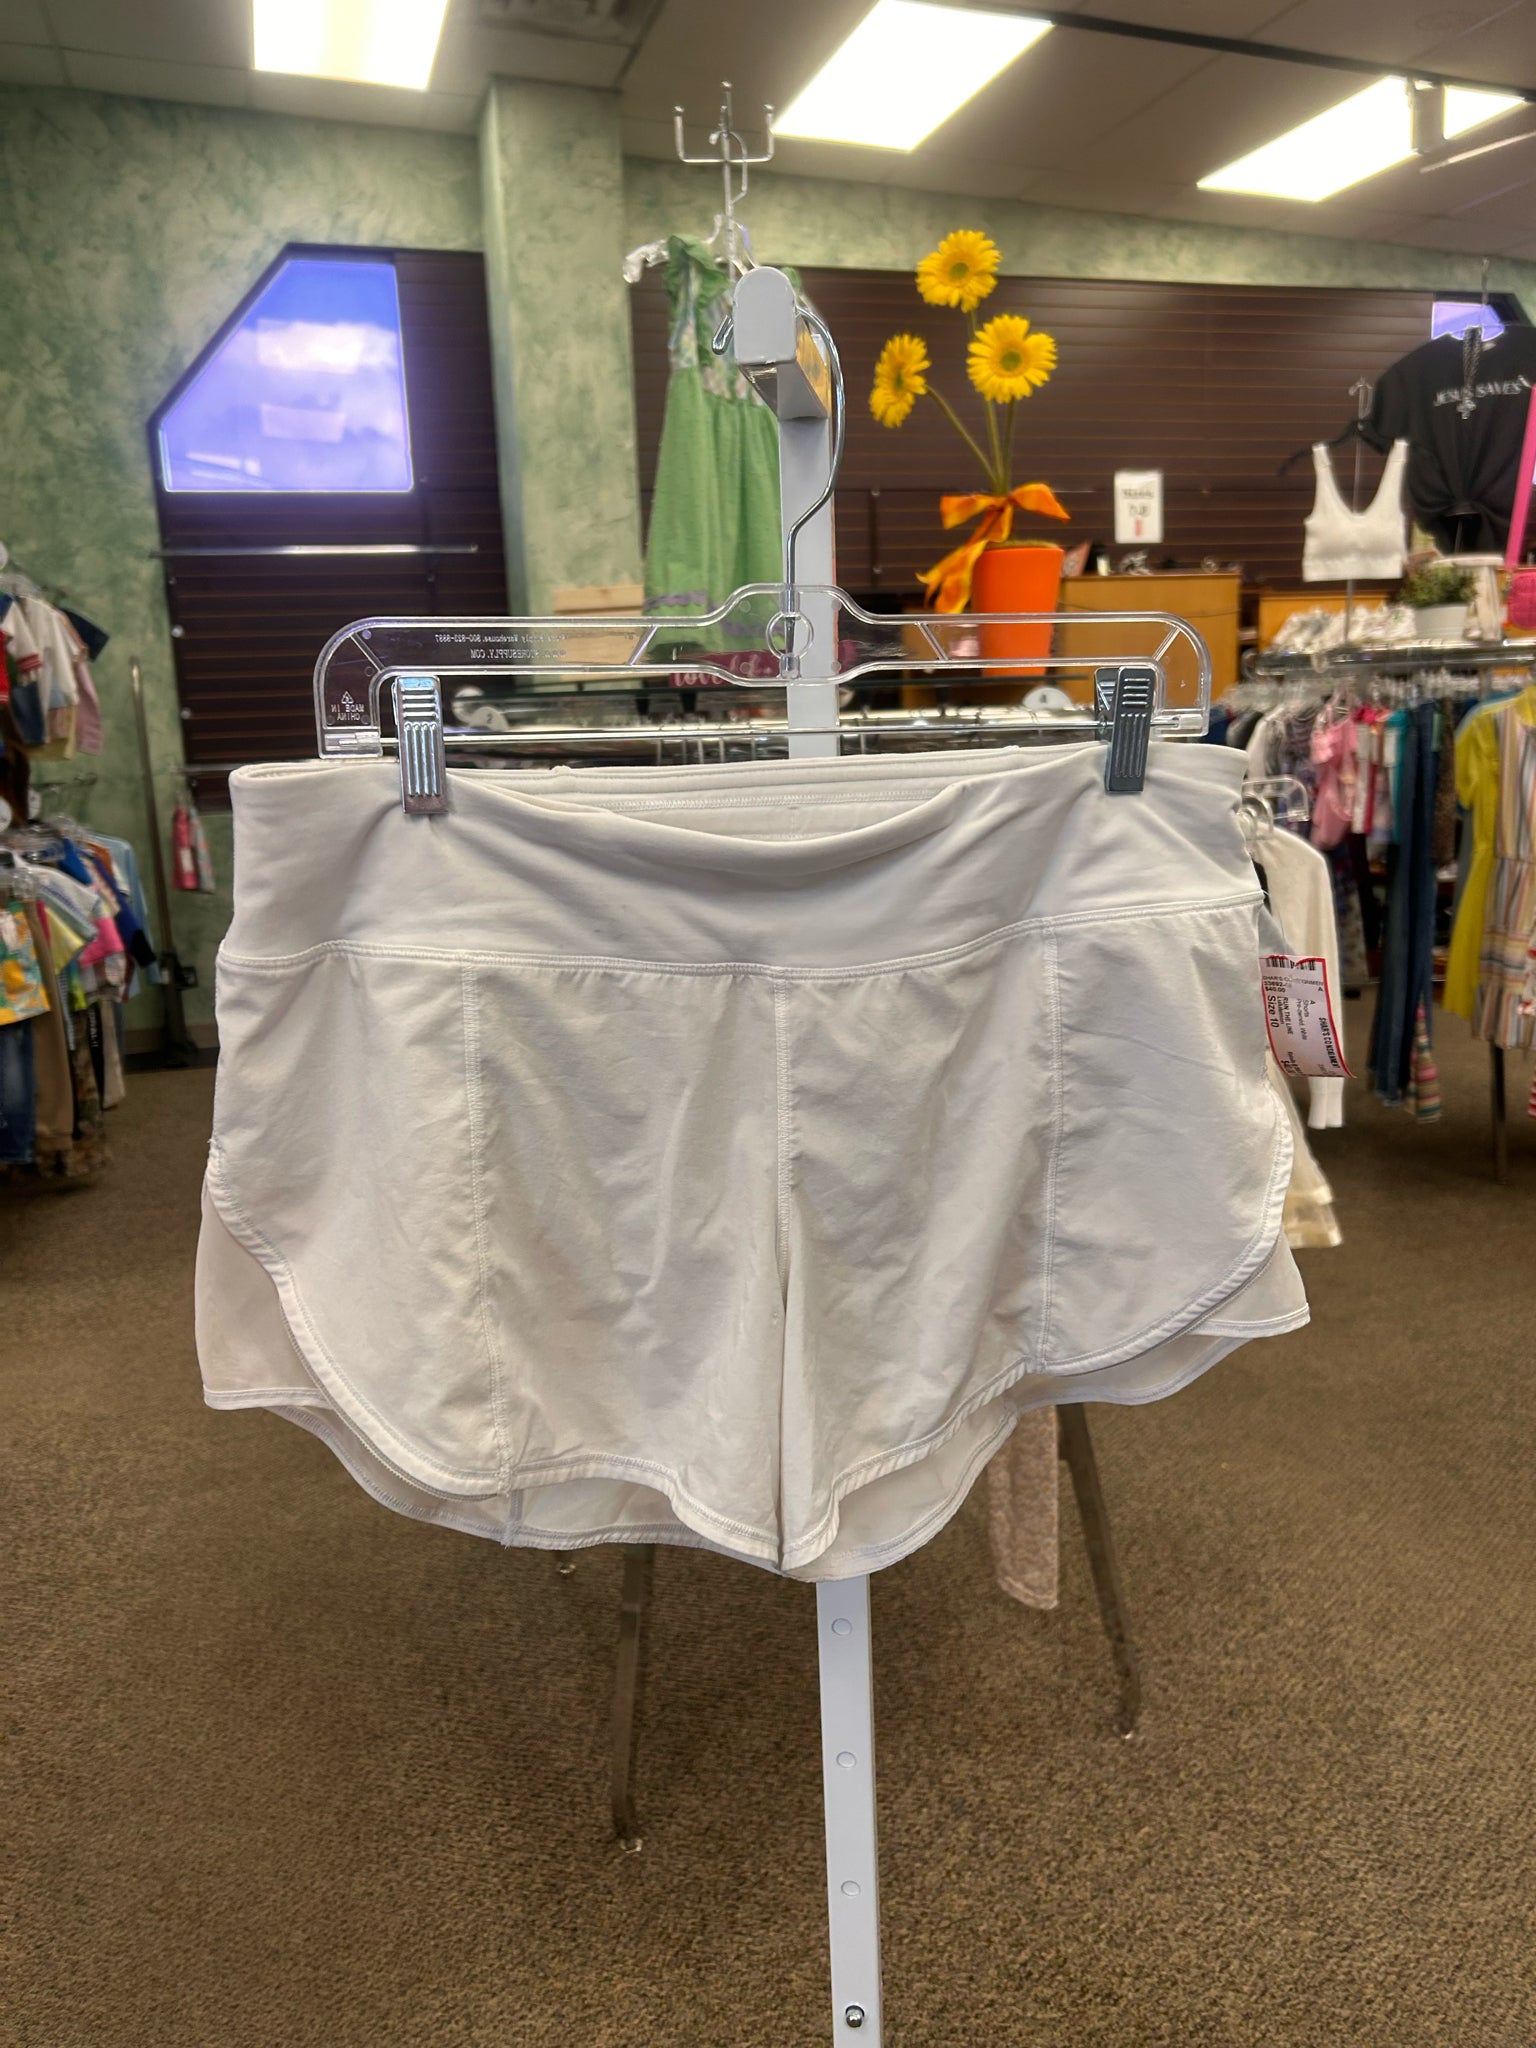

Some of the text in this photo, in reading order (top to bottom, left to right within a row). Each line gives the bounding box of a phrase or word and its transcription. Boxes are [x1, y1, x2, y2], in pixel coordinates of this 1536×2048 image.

[1475, 381, 1522, 398] SAVES
[1267, 995, 1280, 1028] Size 10
[1319, 1017, 1330, 1036] SHAR'S
